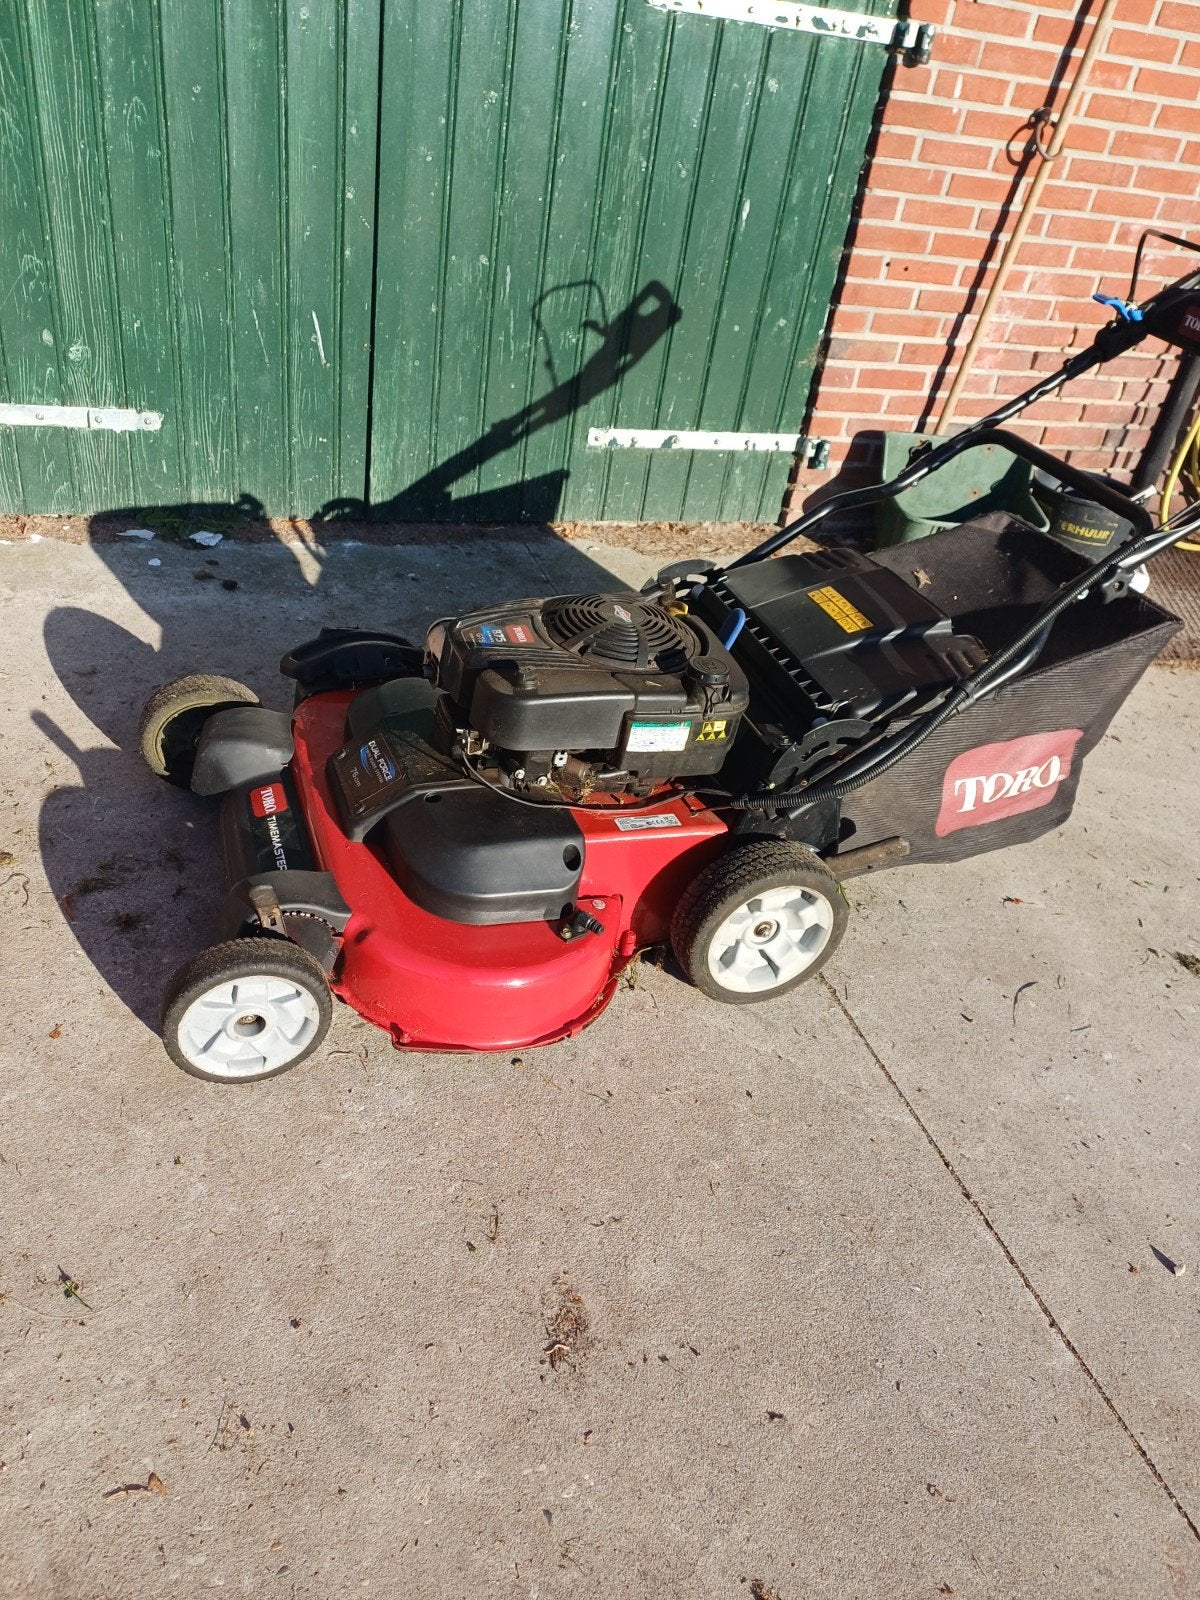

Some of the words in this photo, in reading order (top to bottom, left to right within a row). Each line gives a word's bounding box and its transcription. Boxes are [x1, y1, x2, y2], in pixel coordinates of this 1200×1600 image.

[492, 629, 507, 642] 875
[512, 626, 528, 643] TORO
[368, 740, 381, 759] DUAL
[376, 758, 392, 781] FORCE
[350, 766, 361, 788] 76cm
[954, 755, 1061, 813] TORO
[260, 786, 277, 812] TORO
